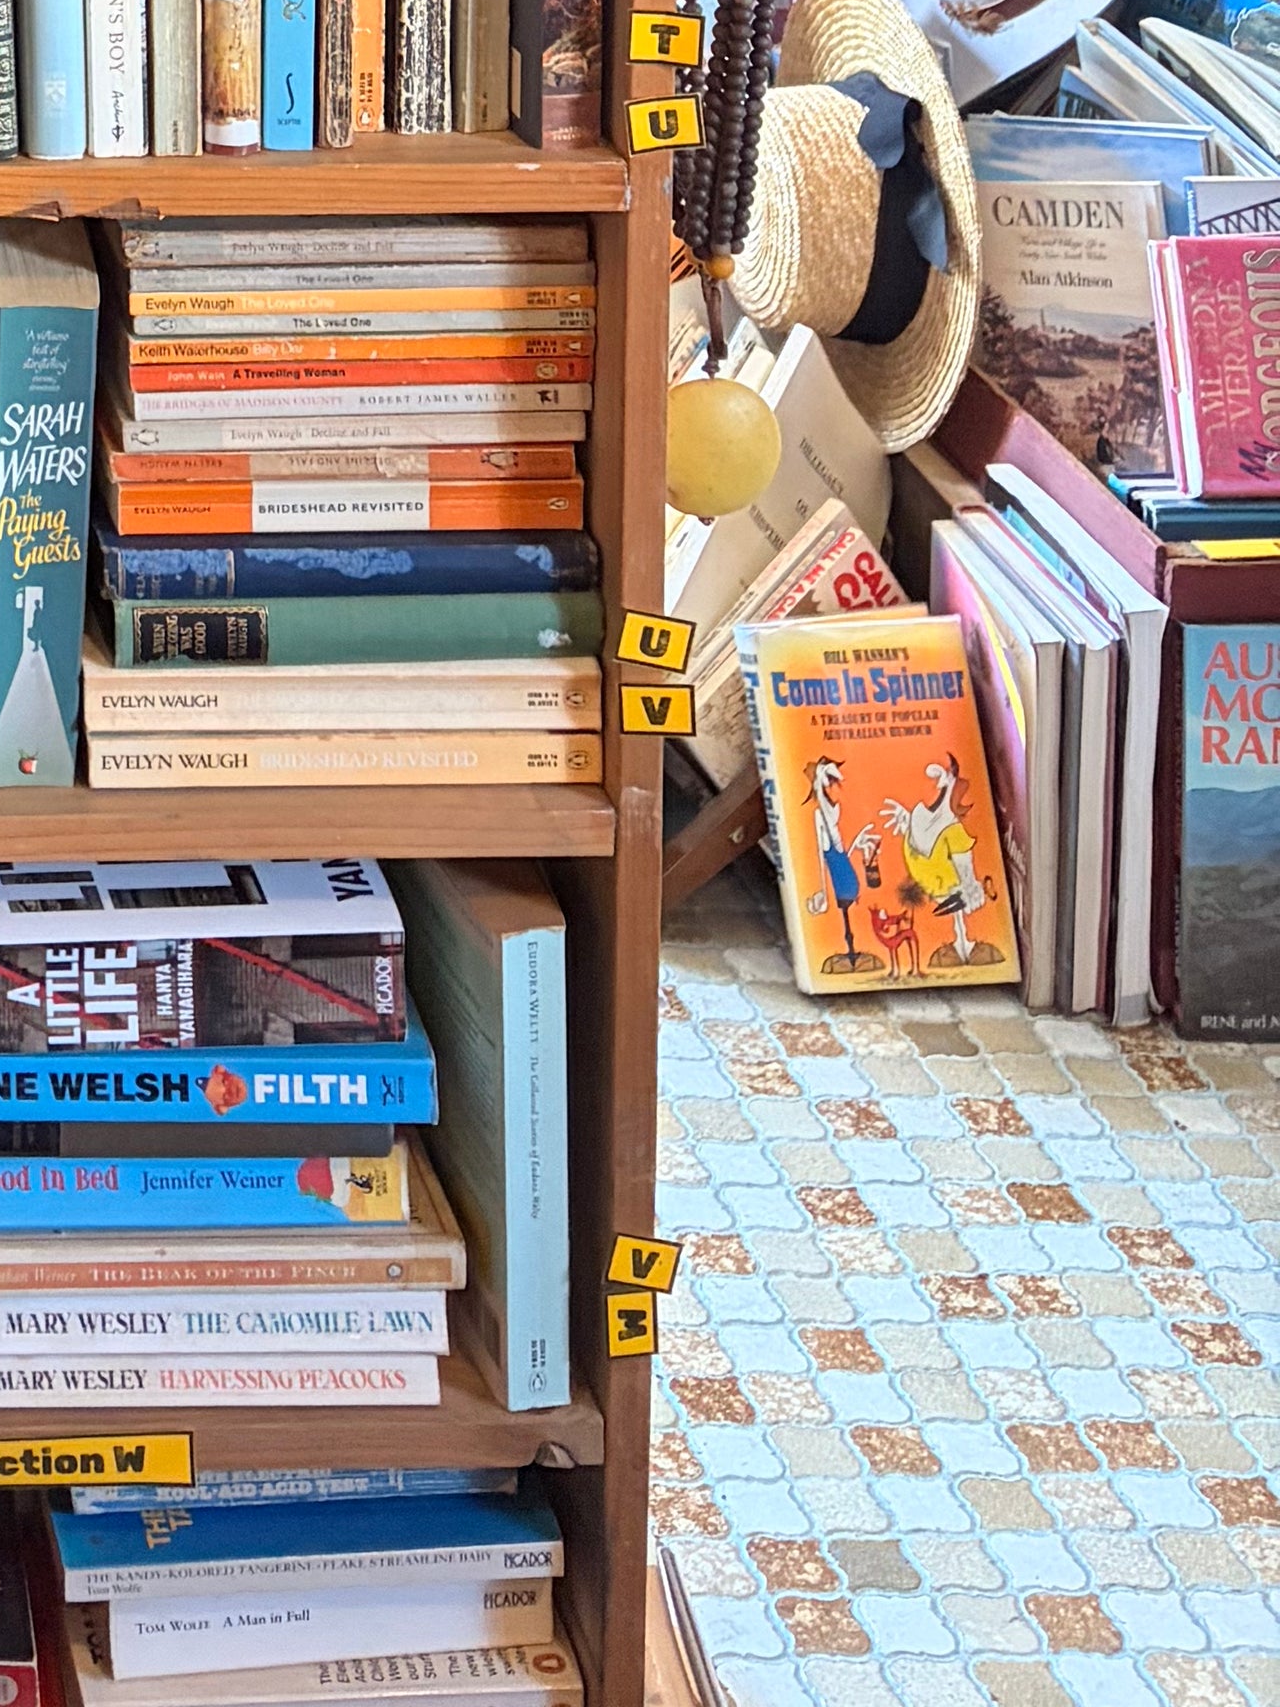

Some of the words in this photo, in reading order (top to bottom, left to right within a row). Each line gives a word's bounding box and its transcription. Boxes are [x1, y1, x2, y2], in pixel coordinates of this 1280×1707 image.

[652, 26, 678, 55] T
[649, 107, 678, 140] U
[650, 111, 678, 139] U
[991, 195, 1124, 229] CAMDEN
[1019, 269, 1050, 286] Alan
[1053, 270, 1113, 288] Atkinson
[3, 402, 84, 442] SARAH
[639, 627, 672, 657] U
[772, 673, 839, 707] Come
[844, 670, 869, 704] In
[873, 668, 968, 701] Spinner
[641, 695, 672, 725] V
[101, 754, 170, 770] EVELYN
[177, 753, 248, 769] WAUGH
[50, 1073, 190, 1102] WELSH
[254, 1073, 369, 1105] FILTH
[5, 1312, 71, 1335] MARY
[76, 1312, 171, 1335] WESLEY
[113, 1446, 147, 1473] W
